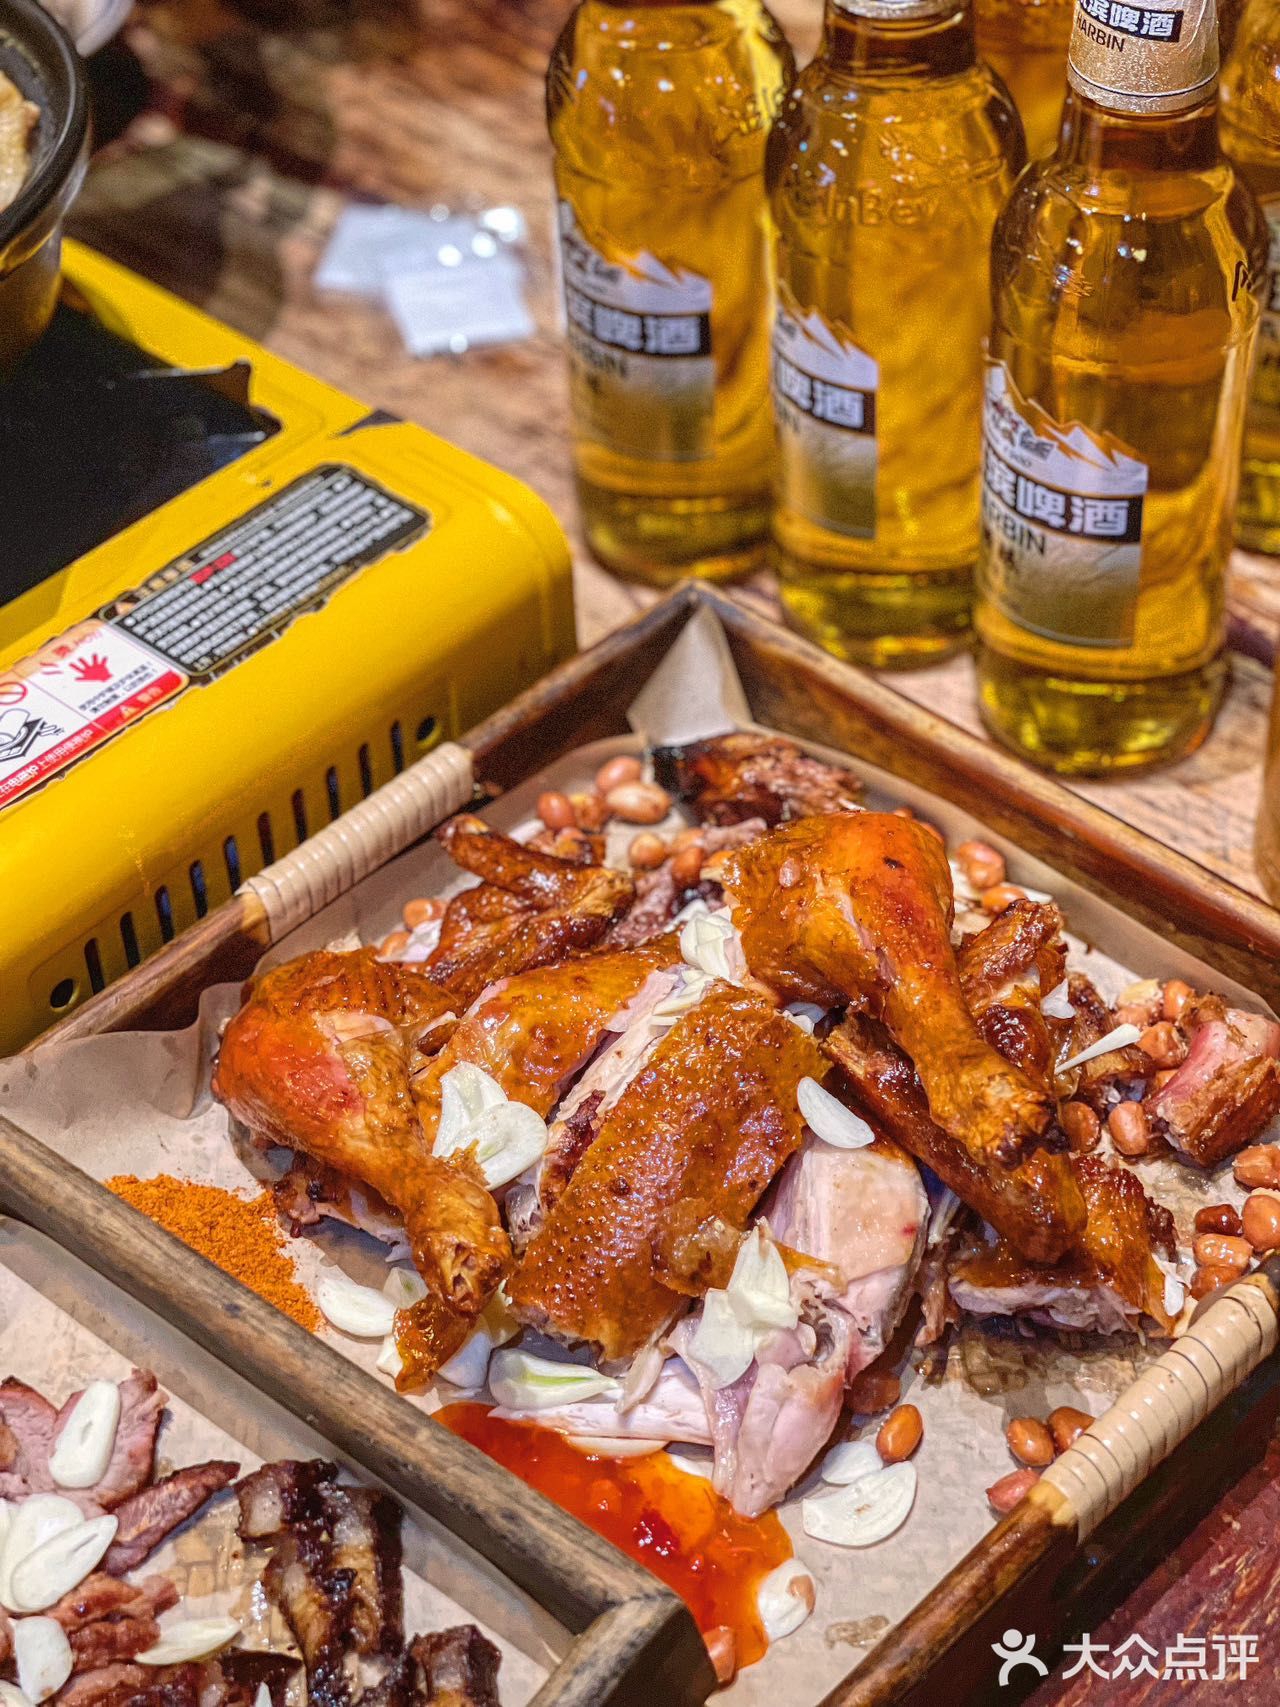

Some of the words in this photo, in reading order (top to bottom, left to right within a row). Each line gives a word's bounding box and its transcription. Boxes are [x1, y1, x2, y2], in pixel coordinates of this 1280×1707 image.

[1077, 11, 1125, 53] HARBIN
[1082, 0, 1176, 37] 滨啤酒
